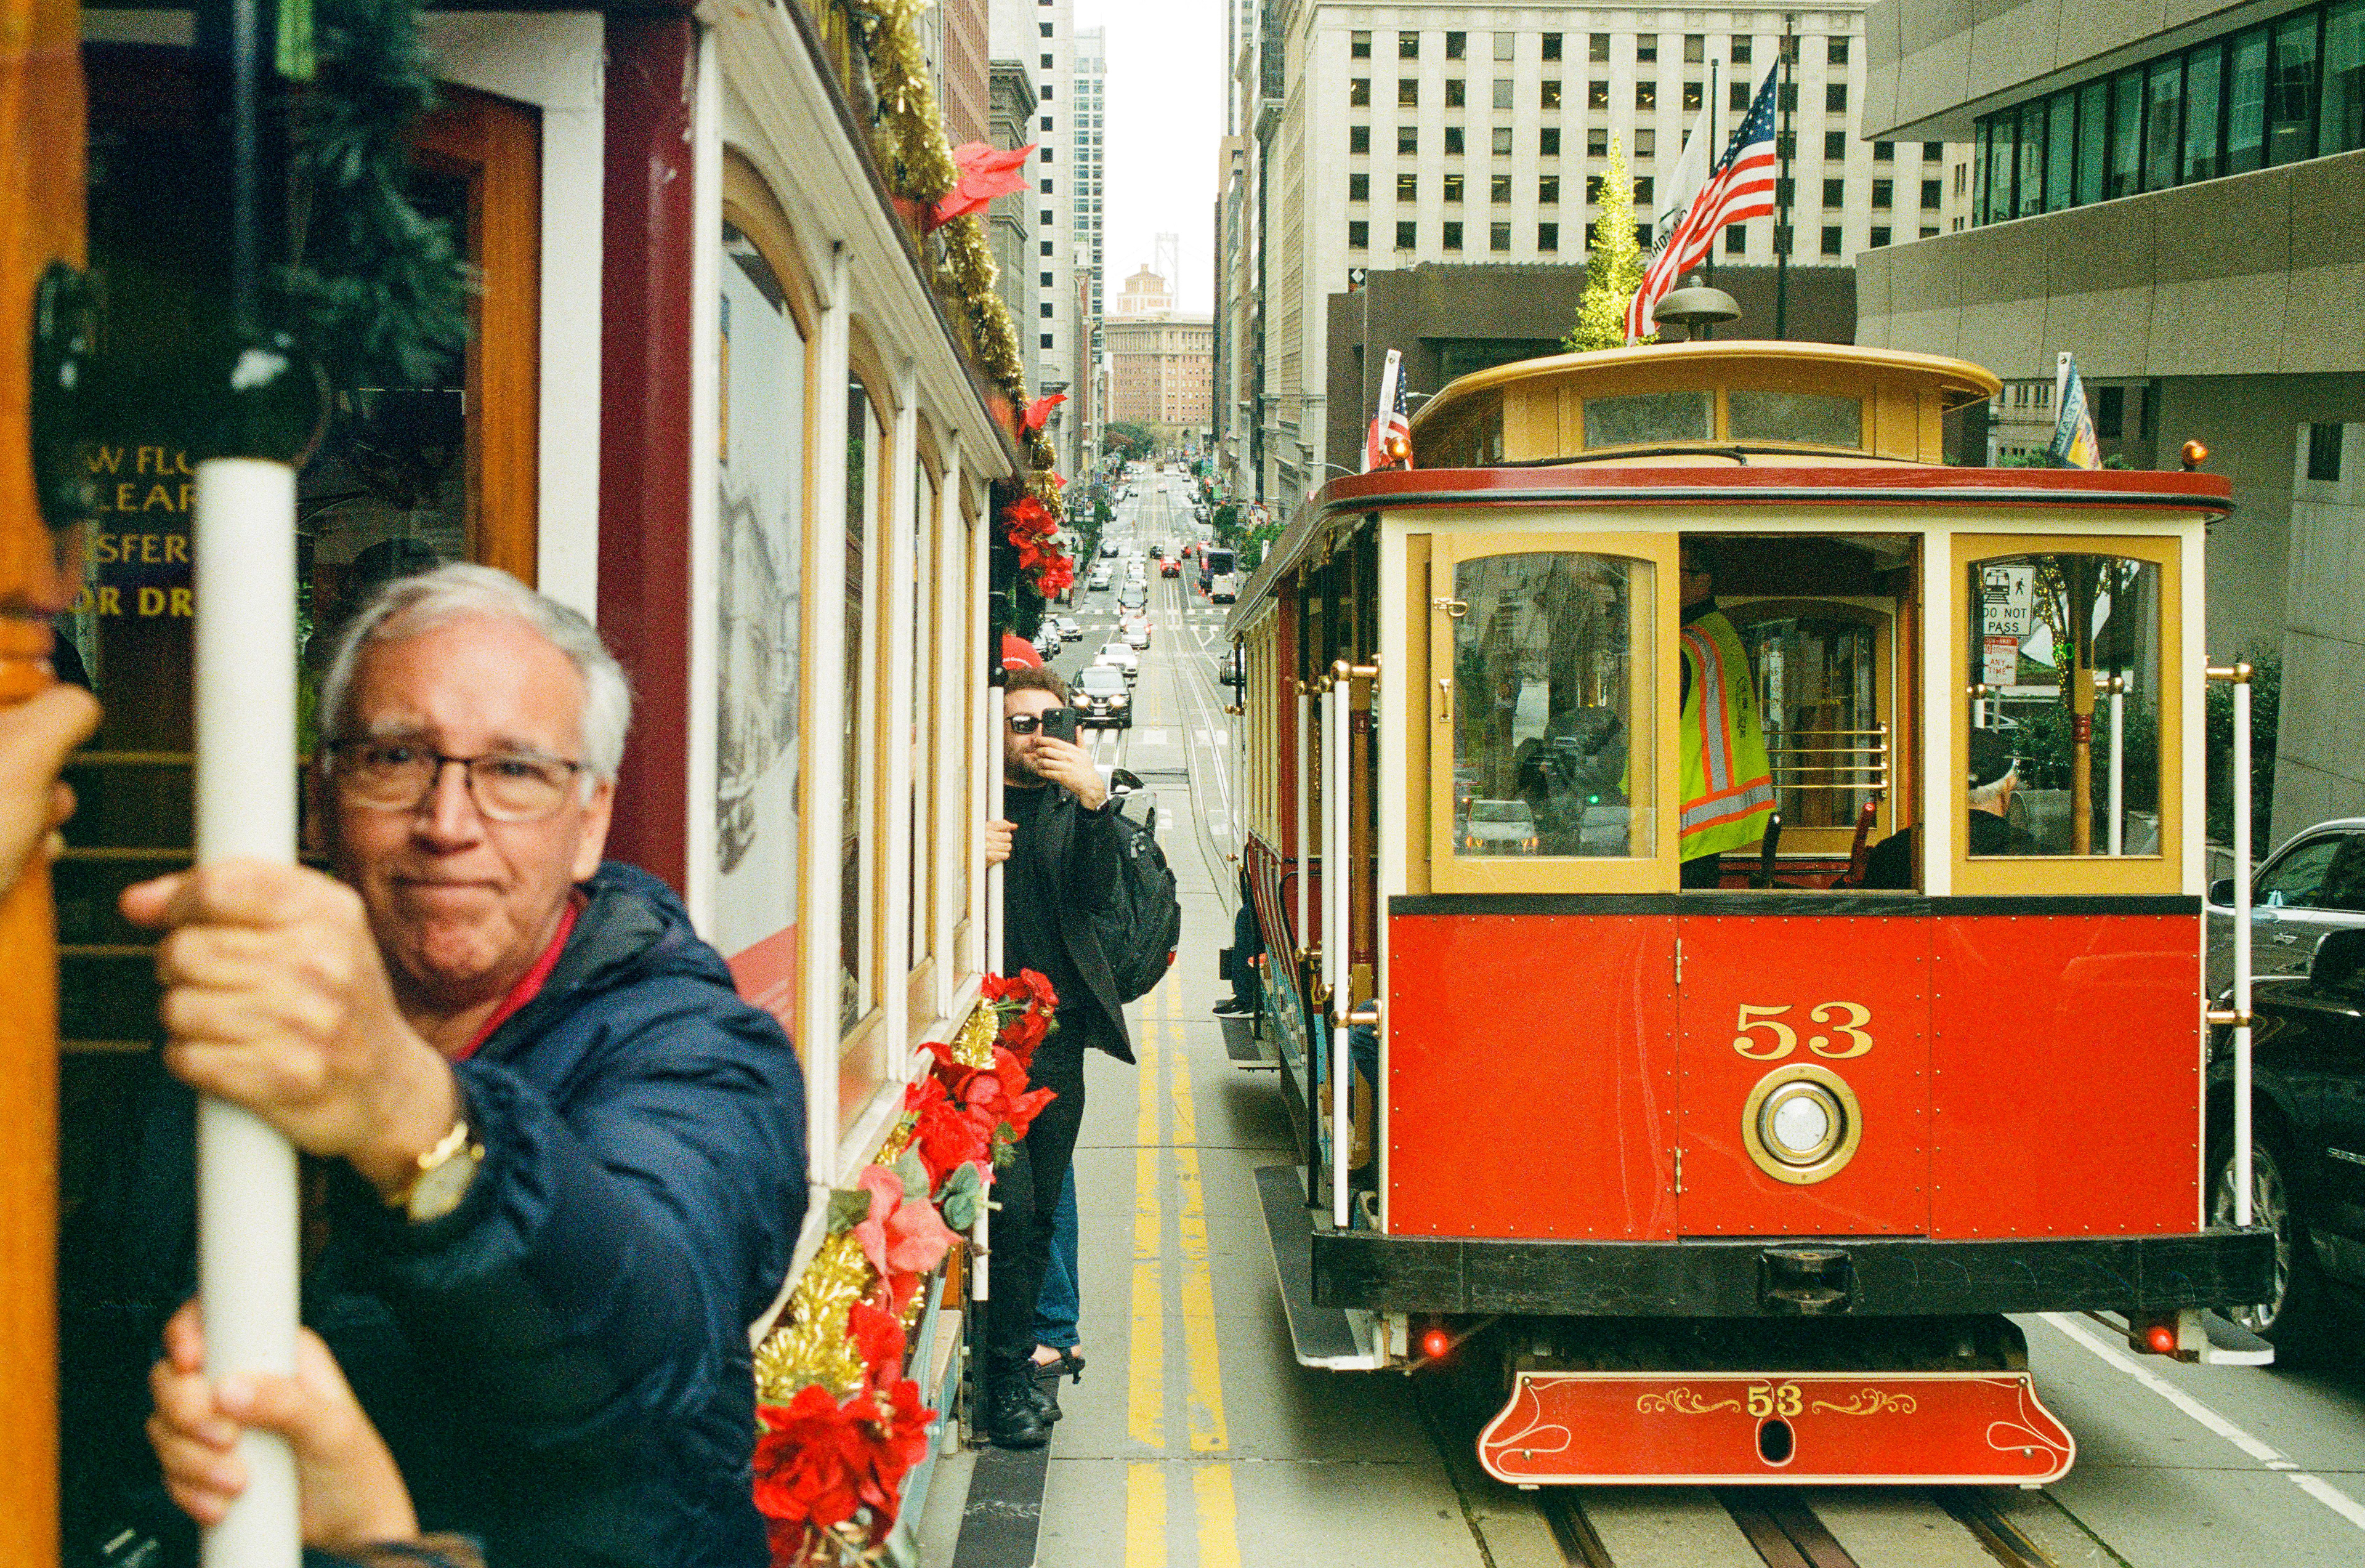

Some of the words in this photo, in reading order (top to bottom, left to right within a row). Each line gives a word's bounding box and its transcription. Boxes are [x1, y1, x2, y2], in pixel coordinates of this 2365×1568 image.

[137, 587, 196, 616] DR
[2004, 608, 2026, 618] NOT
[1988, 622, 2019, 632] PASS
[1989, 666, 2006, 674] TIME
[1732, 1001, 1874, 1060] 53
[1747, 1386, 1804, 1417] 53
